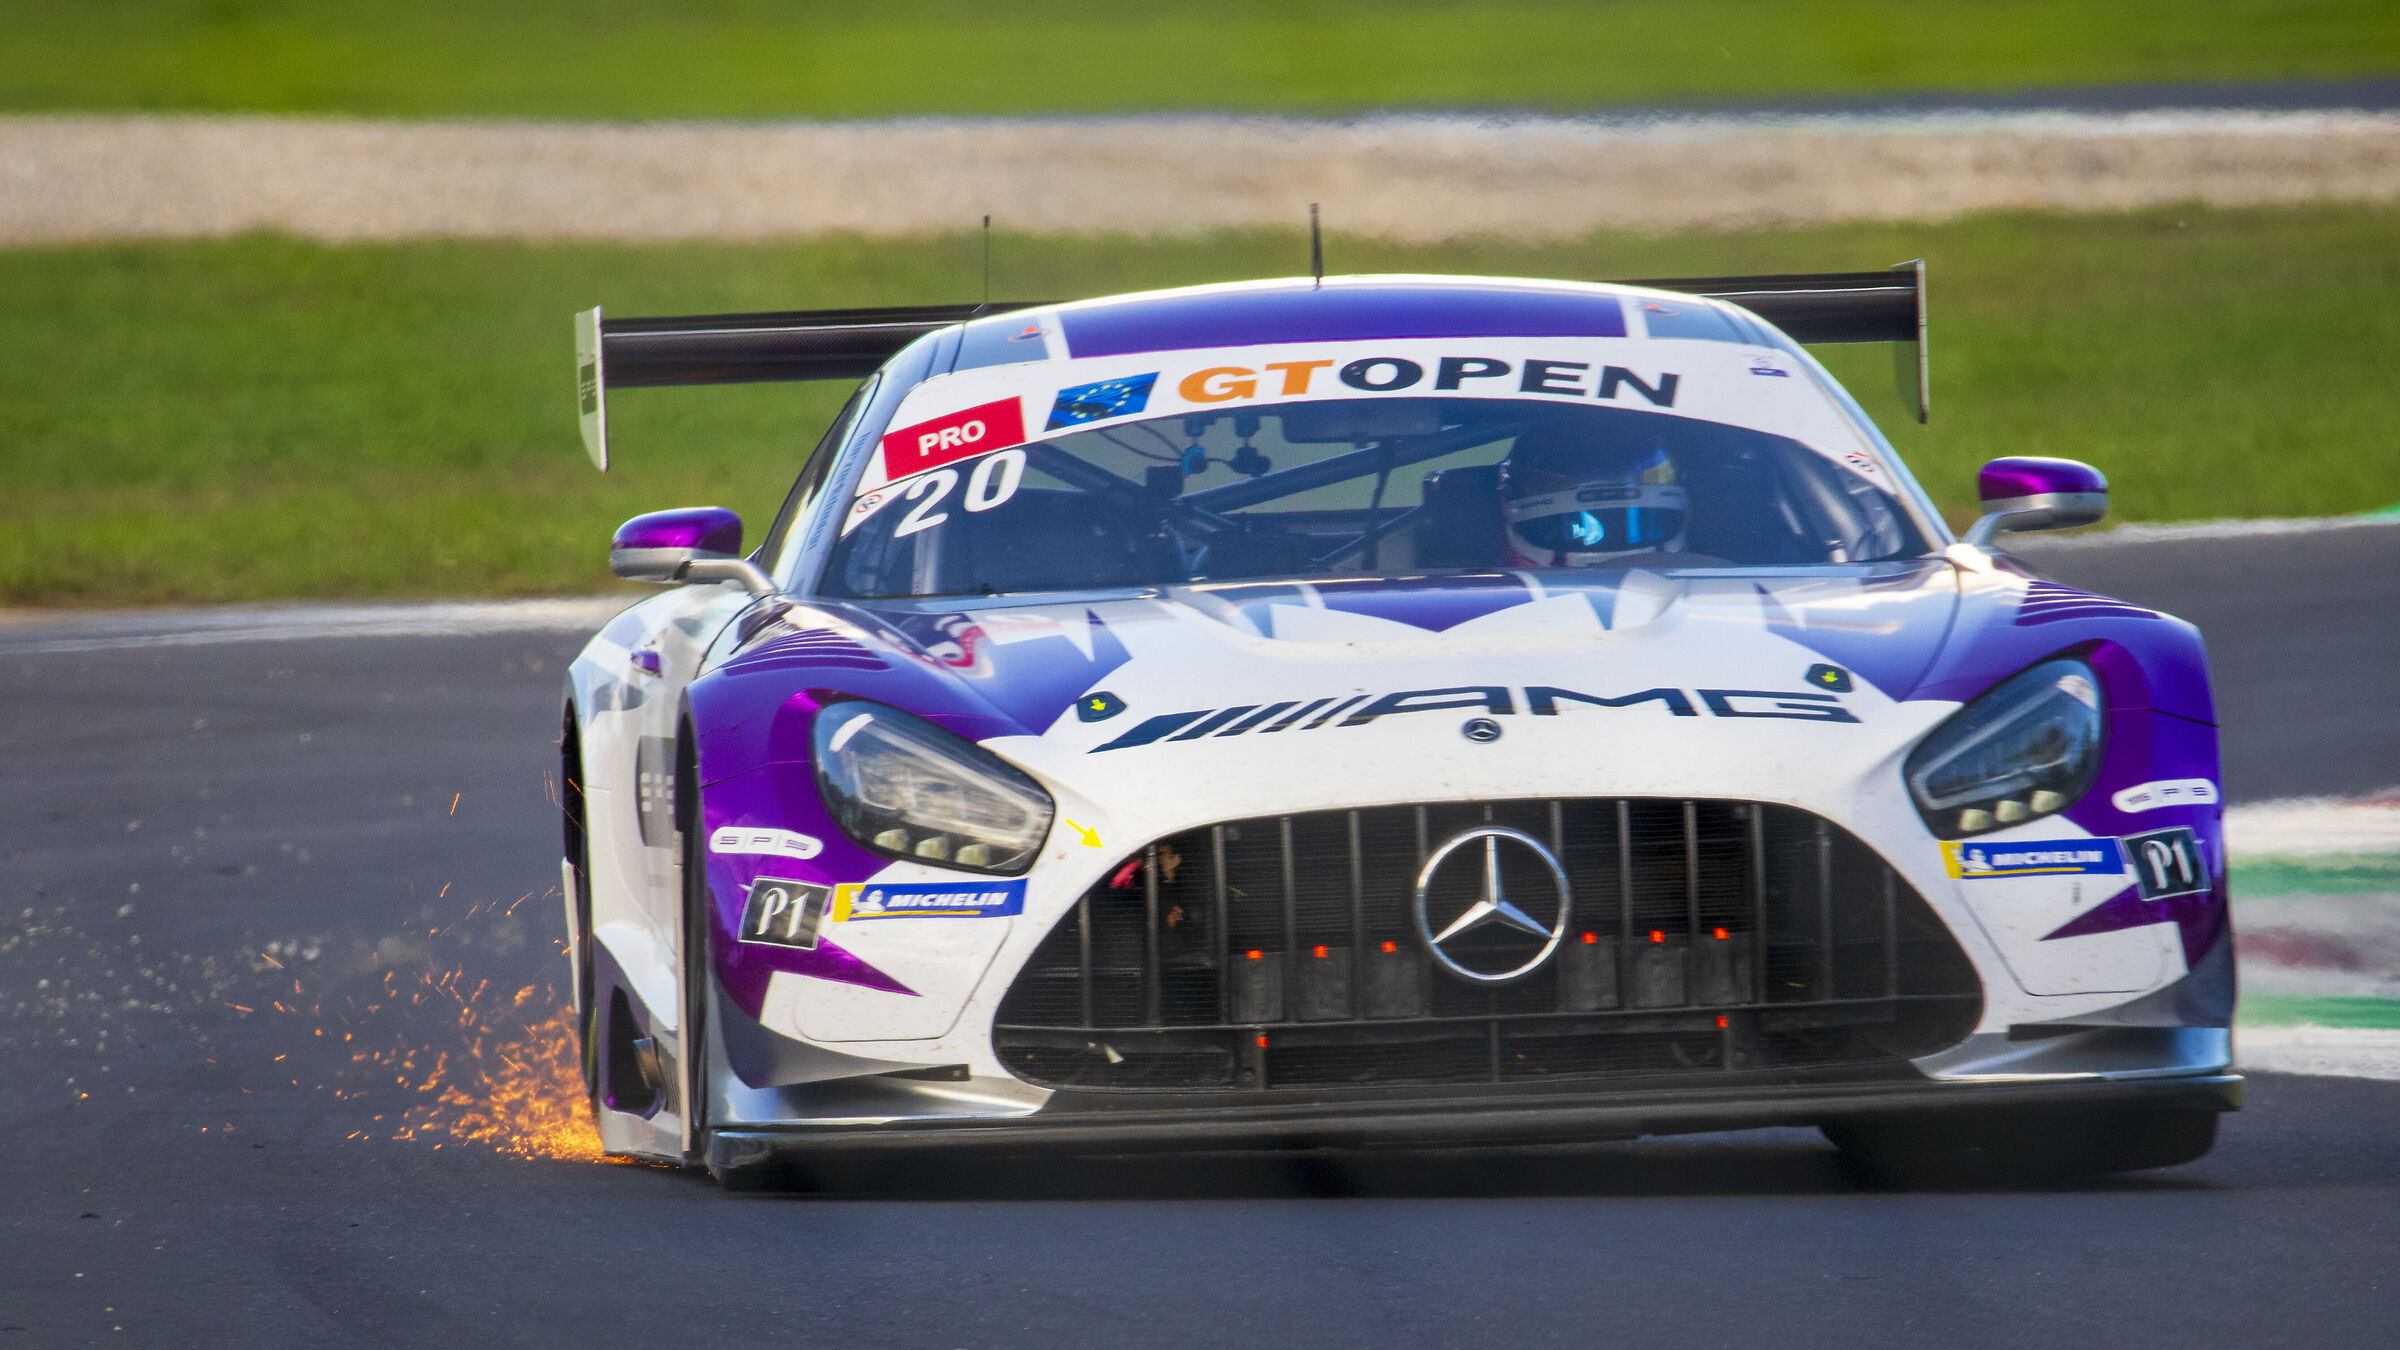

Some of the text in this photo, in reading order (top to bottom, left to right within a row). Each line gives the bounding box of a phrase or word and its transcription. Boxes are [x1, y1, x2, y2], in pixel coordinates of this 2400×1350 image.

[919, 420, 986, 456] PRO
[894, 449, 1027, 538] 20
[719, 835, 810, 852] SPS
[1992, 851, 2104, 867] MICHELIN
[2142, 839, 2195, 891] P1
[755, 886, 811, 939] P1
[886, 892, 1010, 907] MICHELIN
